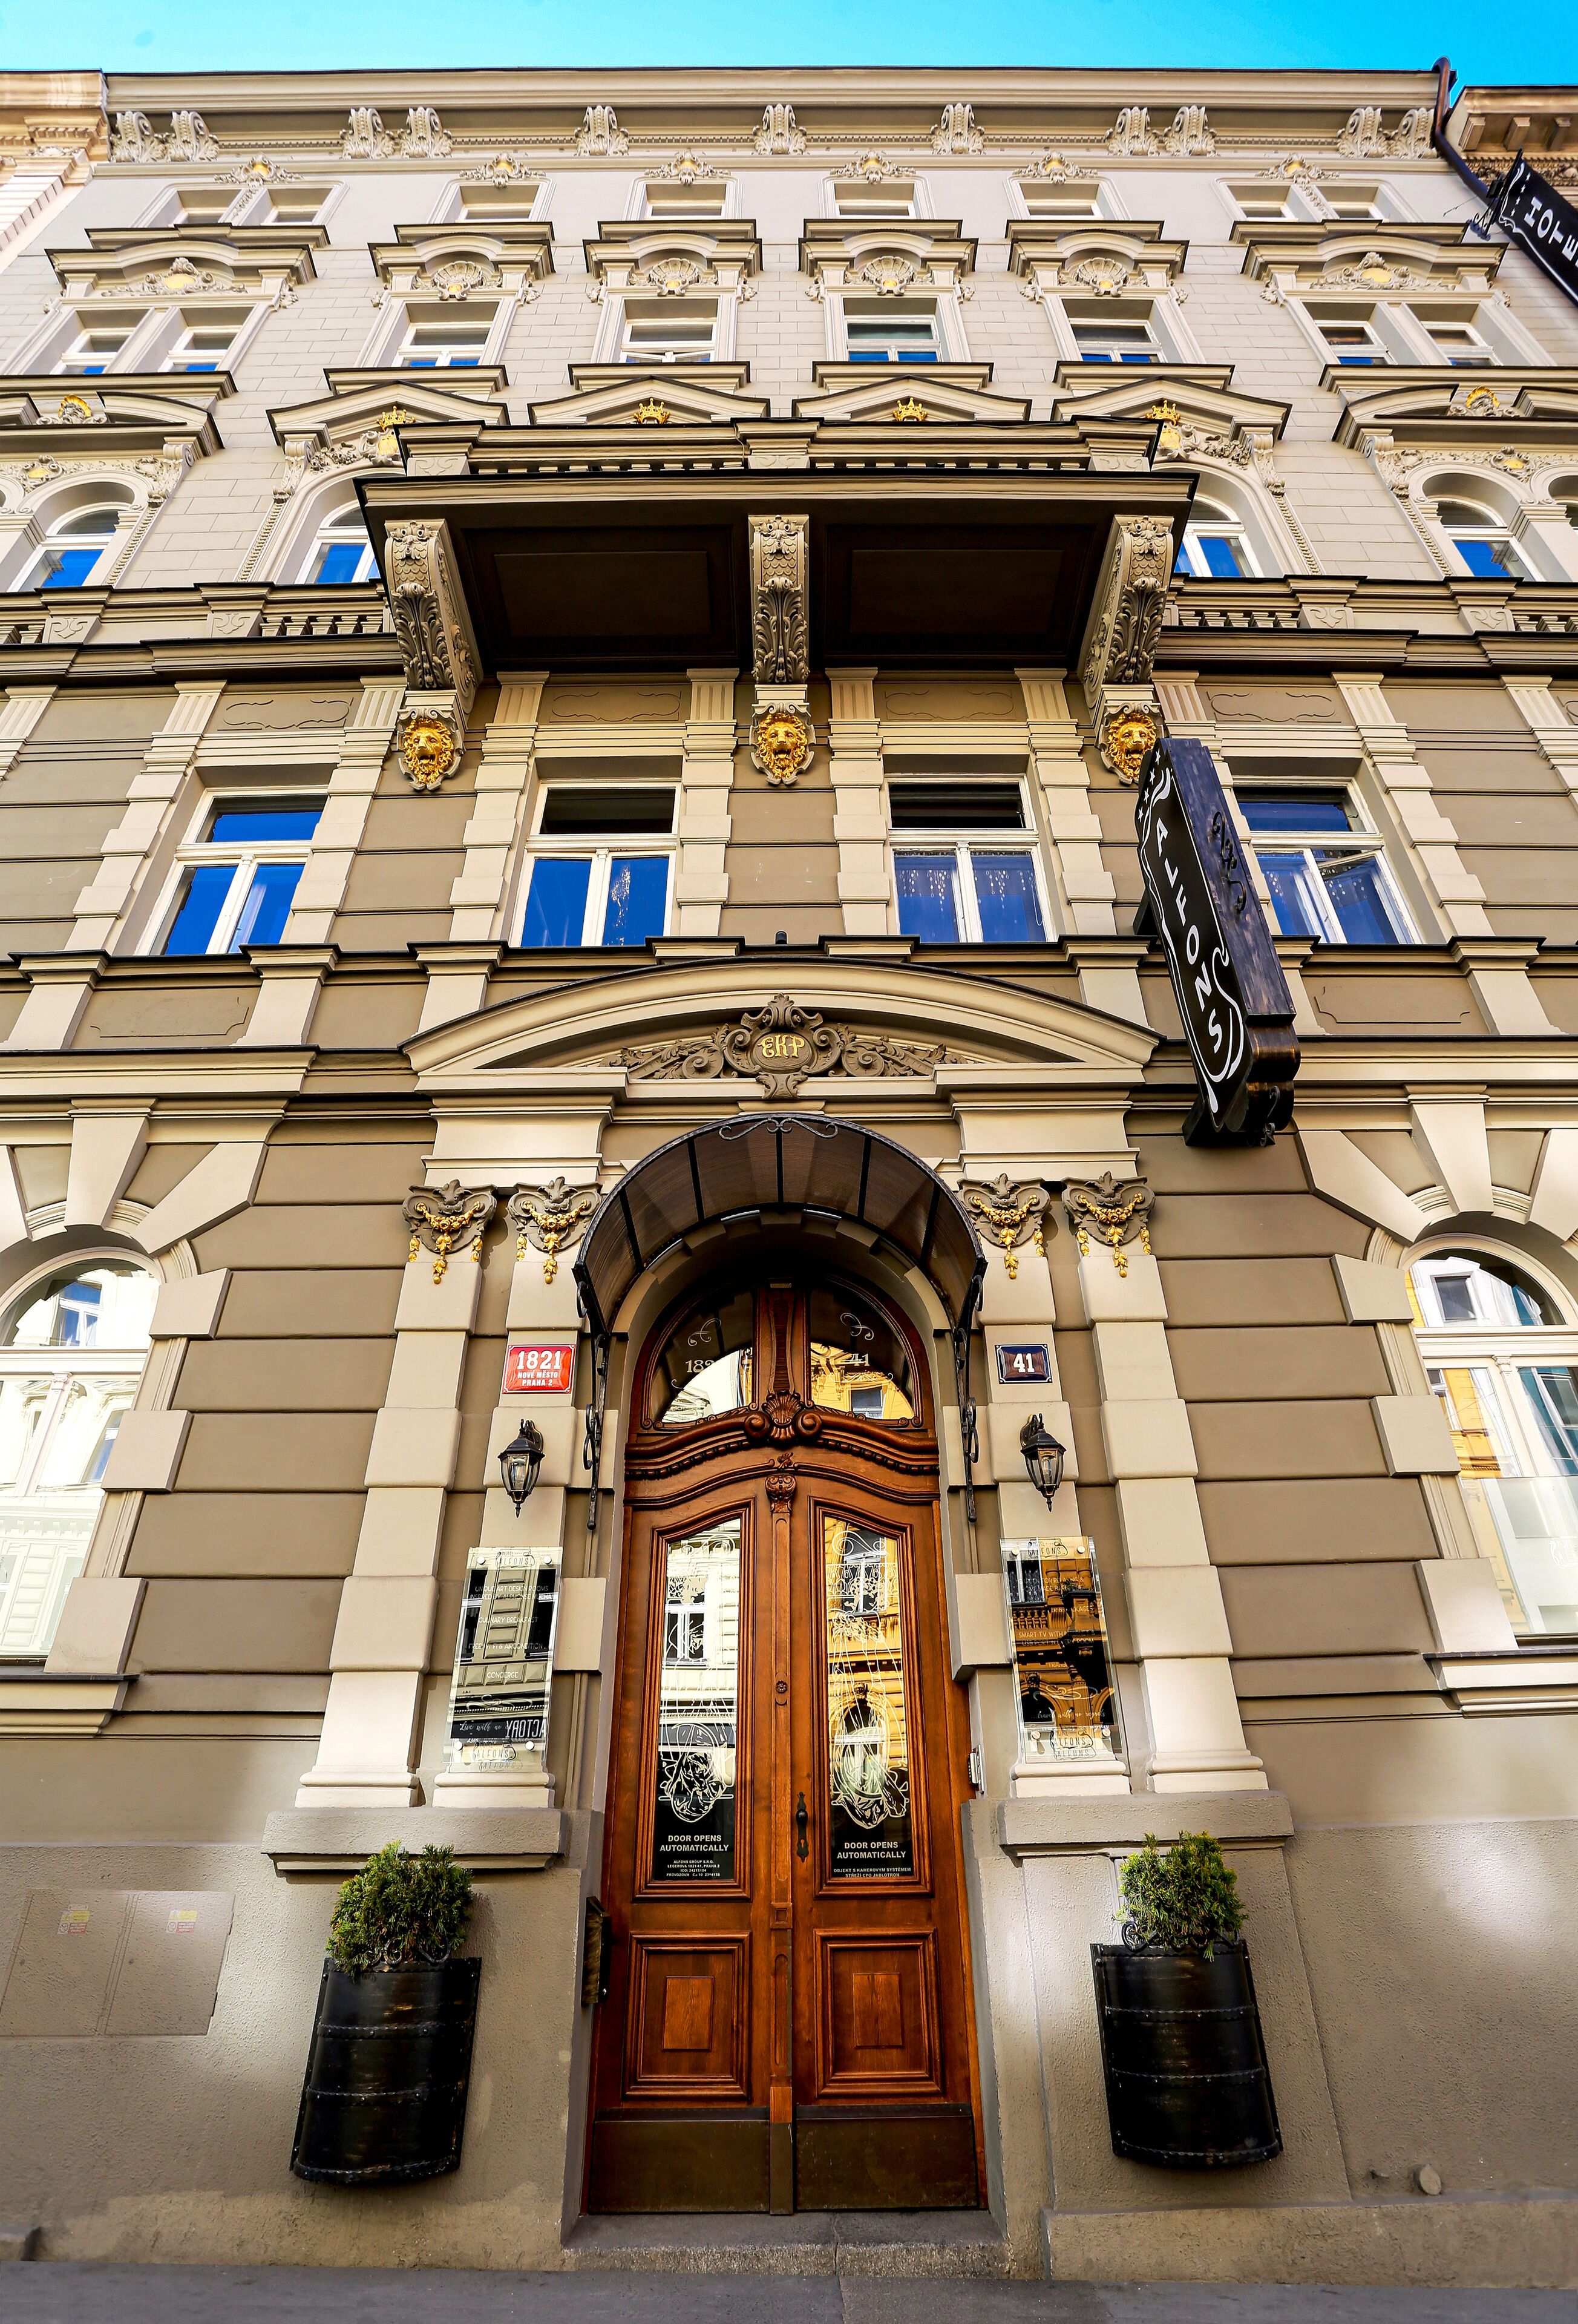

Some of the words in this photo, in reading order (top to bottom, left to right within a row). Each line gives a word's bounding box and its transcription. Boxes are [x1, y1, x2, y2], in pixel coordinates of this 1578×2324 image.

[1524, 196, 1578, 268] HOTE
[1156, 817, 1222, 1054] ALFONS
[517, 1350, 561, 1370] 1821
[1013, 1353, 1035, 1373] 41
[517, 1370, 535, 1379] NOVÉ
[536, 1370, 558, 1379] MĚSTO
[459, 1721, 474, 1731] Live
[476, 1720, 491, 1732] with
[476, 1749, 509, 1758] ALFONS
